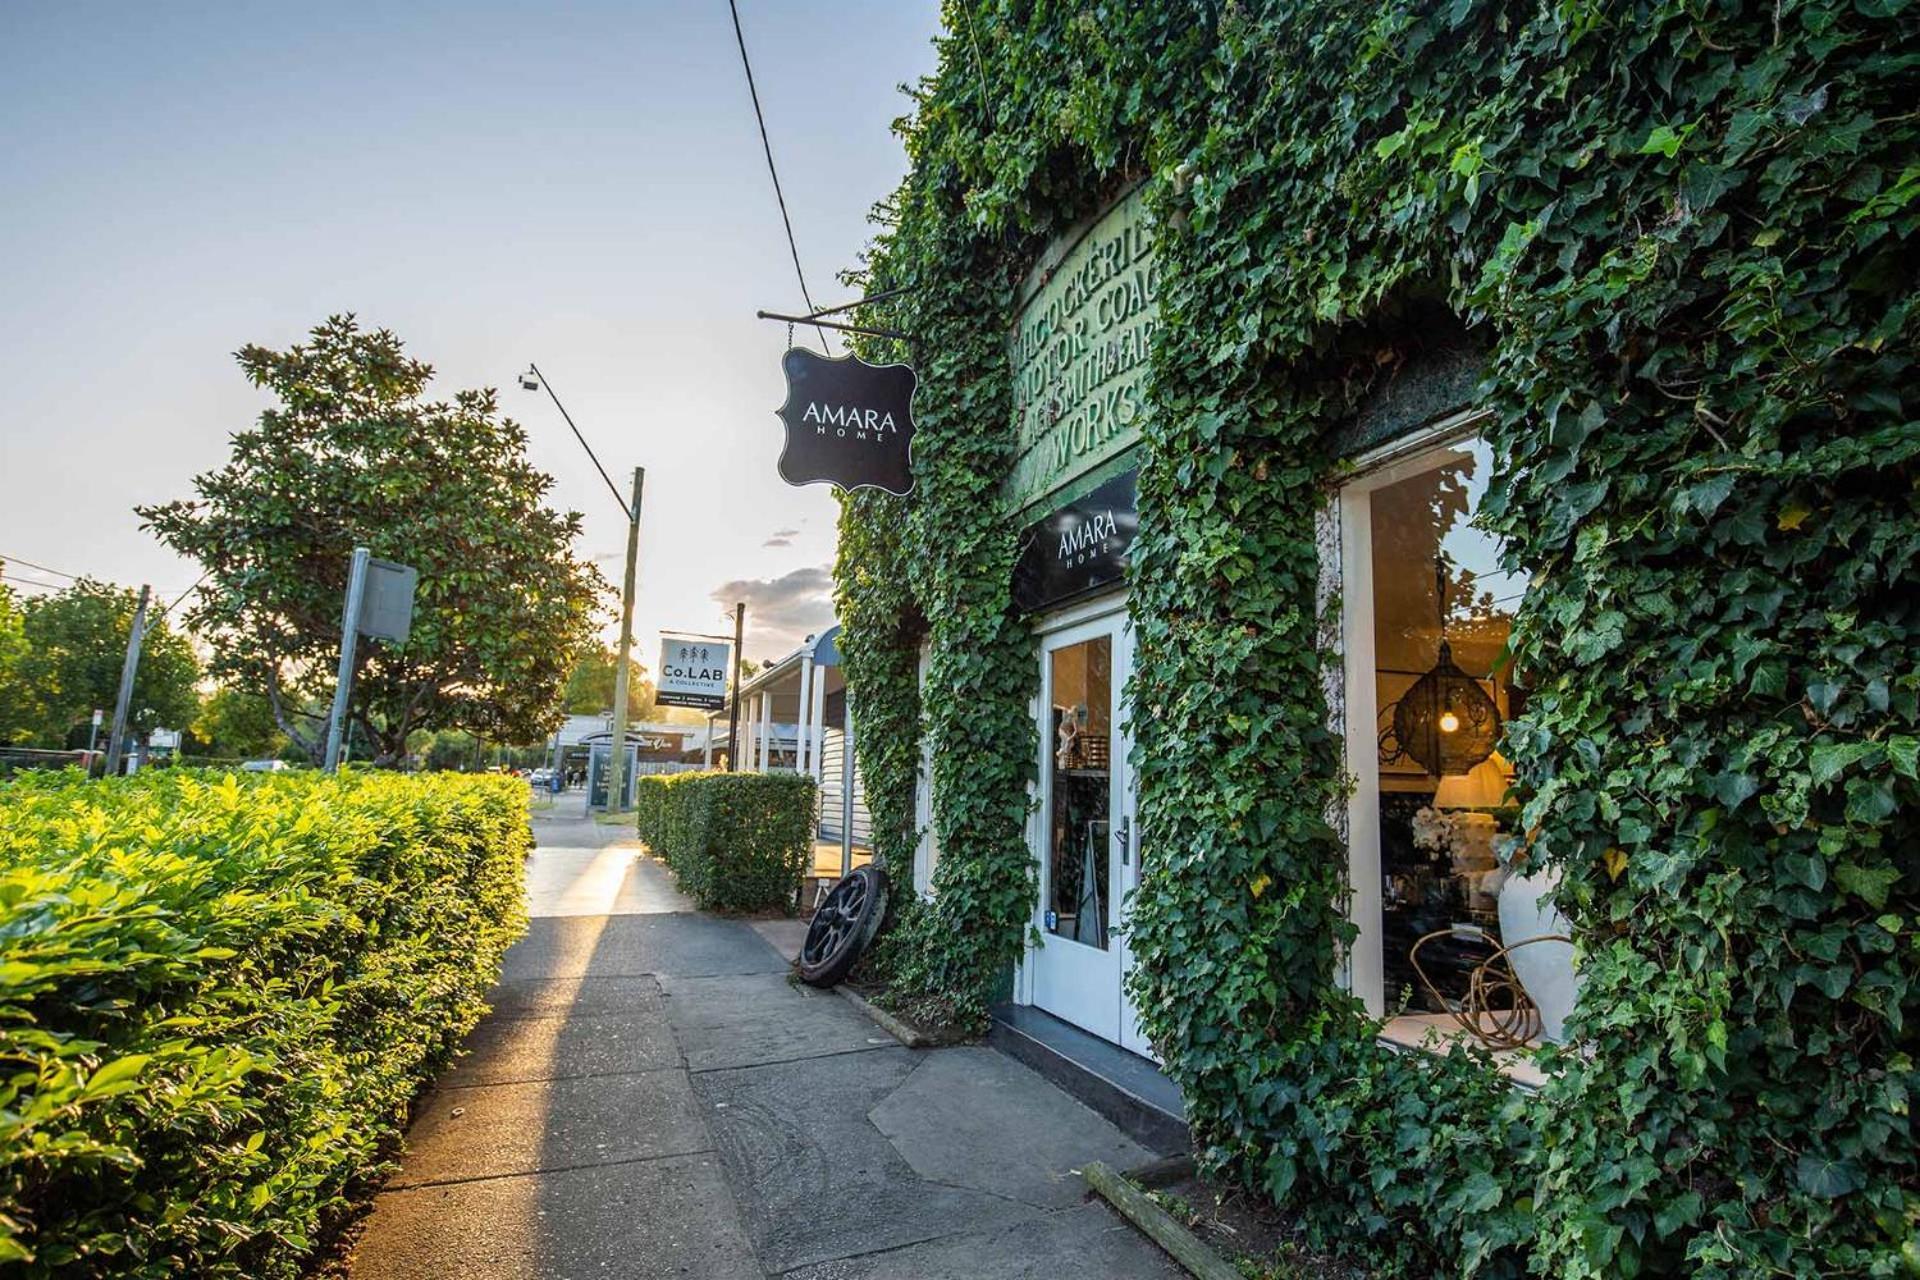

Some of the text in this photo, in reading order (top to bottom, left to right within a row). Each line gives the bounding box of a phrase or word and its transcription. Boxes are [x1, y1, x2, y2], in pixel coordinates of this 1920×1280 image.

[1097, 256, 1161, 333] COAC
[802, 401, 897, 433] AMARA
[816, 425, 883, 442] HOME
[1050, 382, 1136, 472] WORKS
[1058, 509, 1117, 560] AMARA
[1066, 543, 1109, 569] HOME
